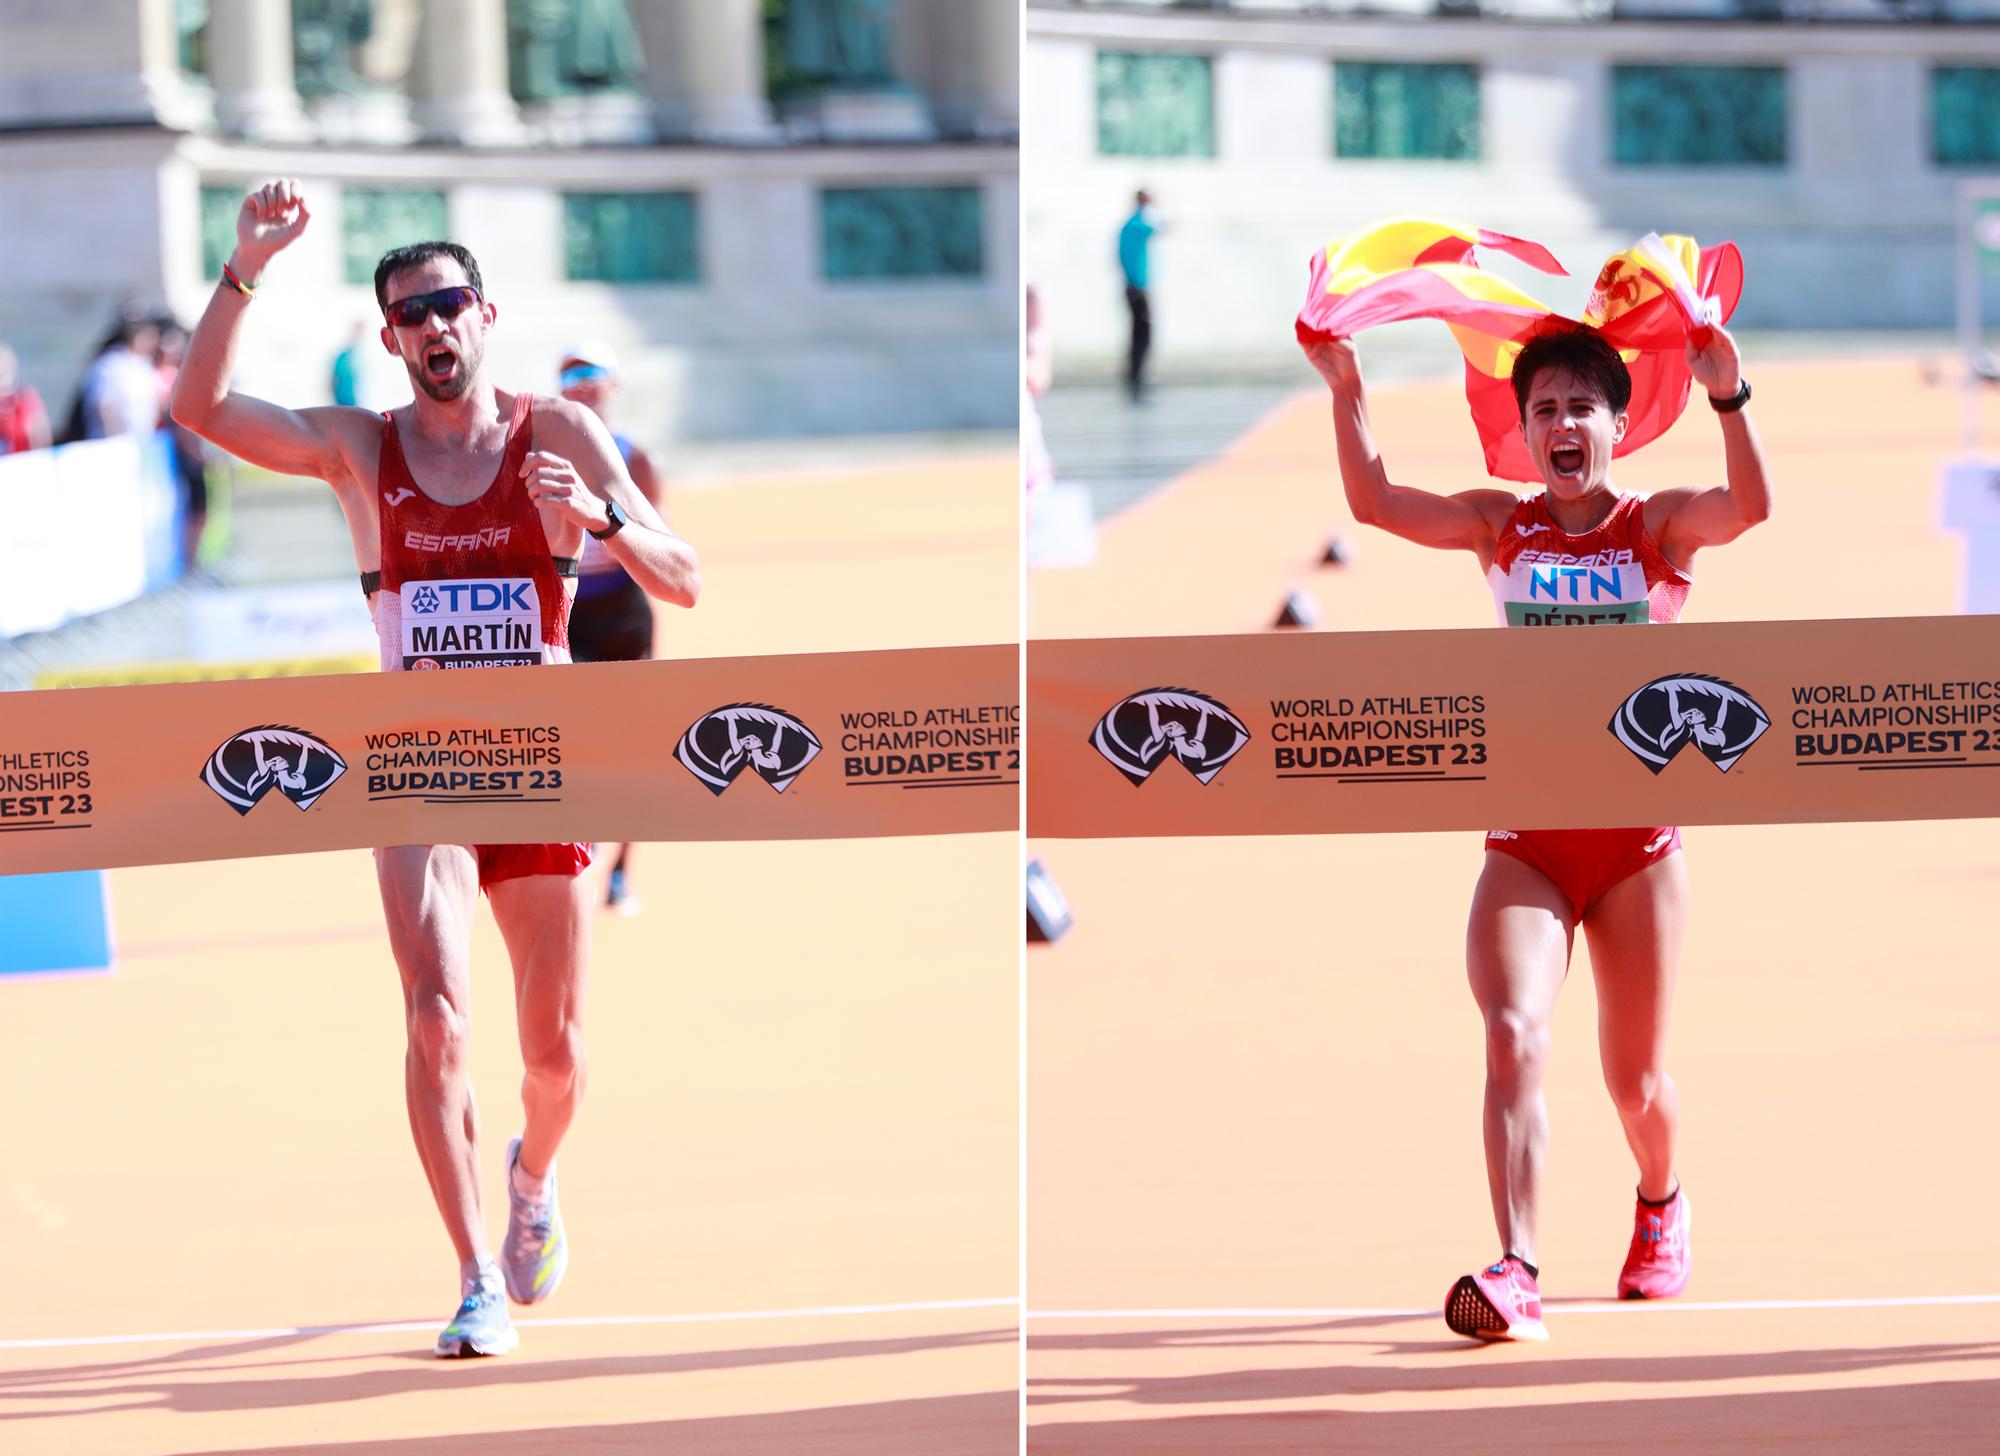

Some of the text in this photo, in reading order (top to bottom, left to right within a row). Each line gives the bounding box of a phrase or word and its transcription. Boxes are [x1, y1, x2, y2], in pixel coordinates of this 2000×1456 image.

[404, 527, 511, 552] ESPAÑA
[1529, 567, 1621, 602] NTN
[439, 583, 531, 612] TDK
[412, 617, 532, 652] MARTÍN
[1270, 695, 1485, 718] WORLD ATHLETICS
[1791, 685, 1875, 704] WORLD
[840, 710, 917, 729] WORLD
[1271, 718, 1486, 742] CHAMPIONSHIPS
[365, 726, 560, 750] WORLD ATHLETICS
[1795, 730, 1967, 756] BUDAPEST
[0, 750, 89, 770] HLETICS
[366, 747, 561, 771] CHAMPIONSHIPS
[844, 751, 1002, 777] BUDAPEST
[1275, 743, 1488, 768] BUDAPEST 23
[368, 770, 562, 793] BUDAPEST 23
[0, 793, 93, 817] EST 23
